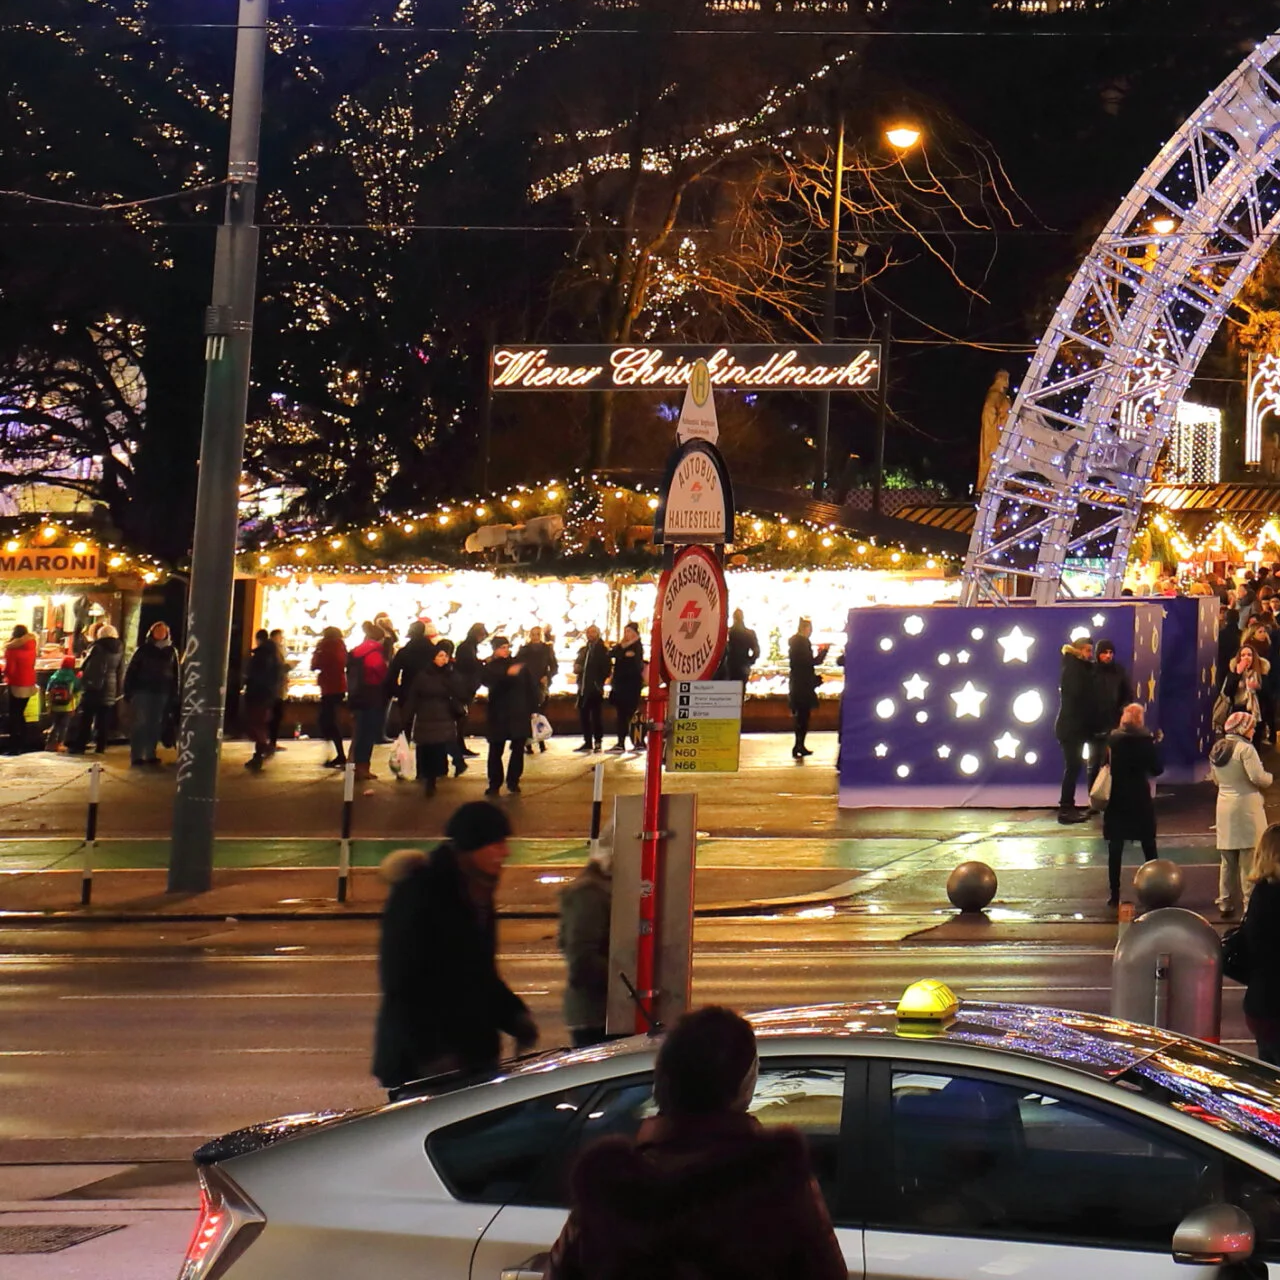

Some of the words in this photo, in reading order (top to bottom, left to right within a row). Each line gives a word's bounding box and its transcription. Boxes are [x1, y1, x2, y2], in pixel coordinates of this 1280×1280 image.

[493, 348, 603, 387] Wiener
[610, 348, 879, 387] Chriskindlmarkt
[678, 457, 717, 491] AUTOBUS
[668, 510, 721, 529] HALTESTELLE
[0, 555, 96, 571] MARONI
[665, 564, 719, 612] STRASSENBAHN
[664, 633, 714, 675] HALTESTELLE
[676, 722, 698, 731] N25
[674, 748, 697, 758] N60
[674, 761, 697, 770] N66
